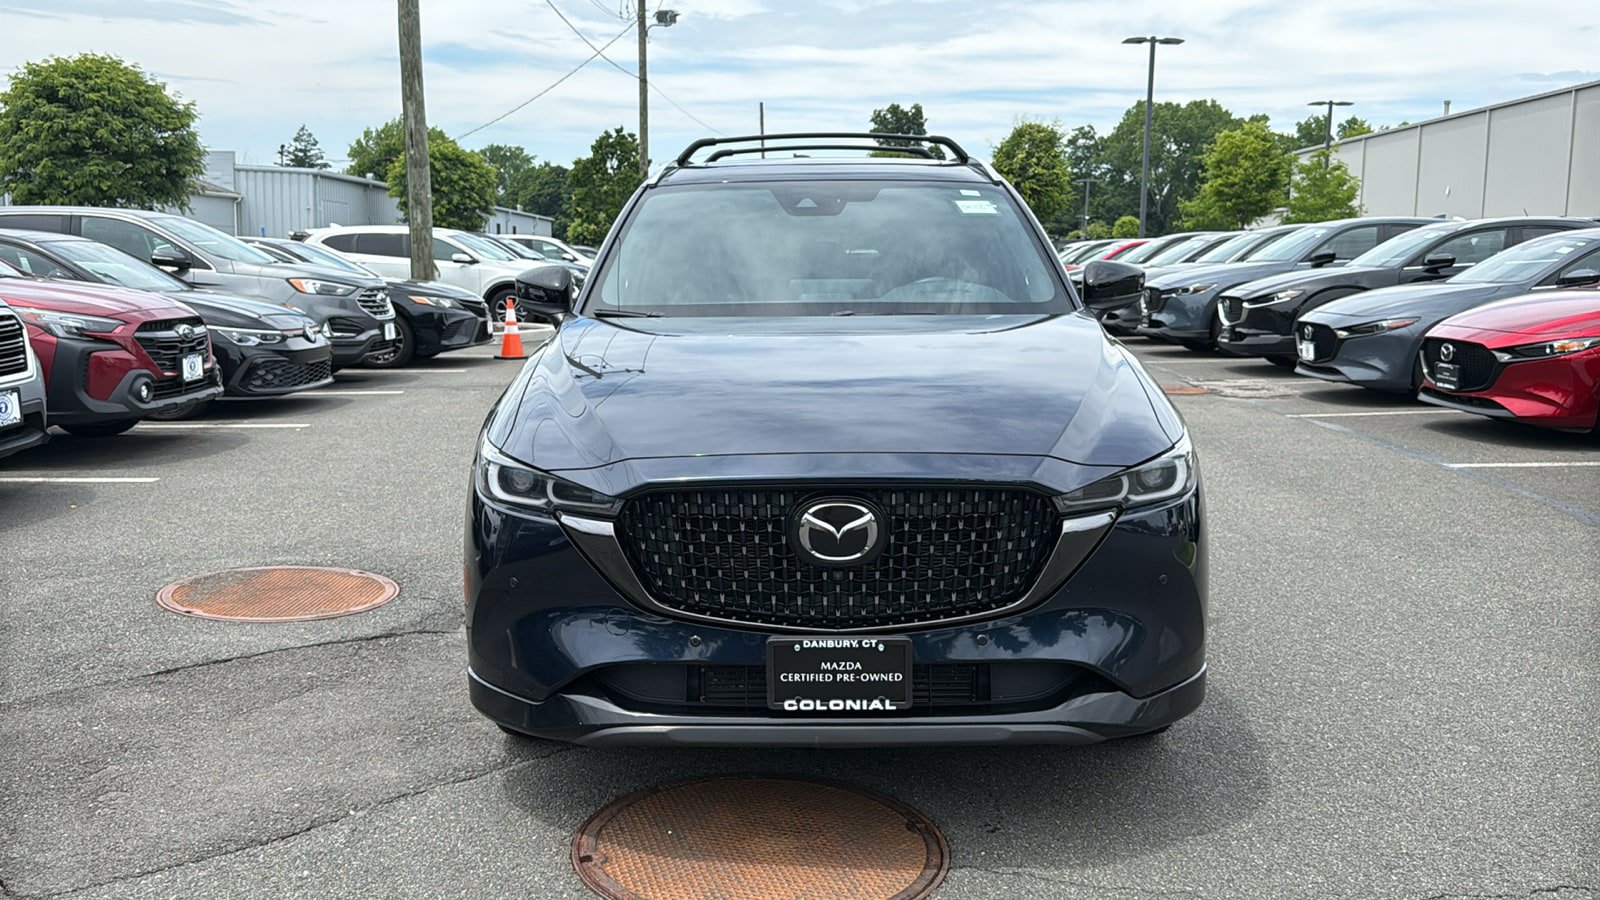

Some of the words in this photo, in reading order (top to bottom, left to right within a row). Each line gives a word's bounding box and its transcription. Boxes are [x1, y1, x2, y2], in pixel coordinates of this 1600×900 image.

[862, 639, 877, 647] CT
[821, 662, 862, 670] MAZDA
[780, 673, 833, 682] CERTIFIED
[836, 673, 903, 682] PRE-OWNED
[783, 699, 897, 711] COLONIAL
